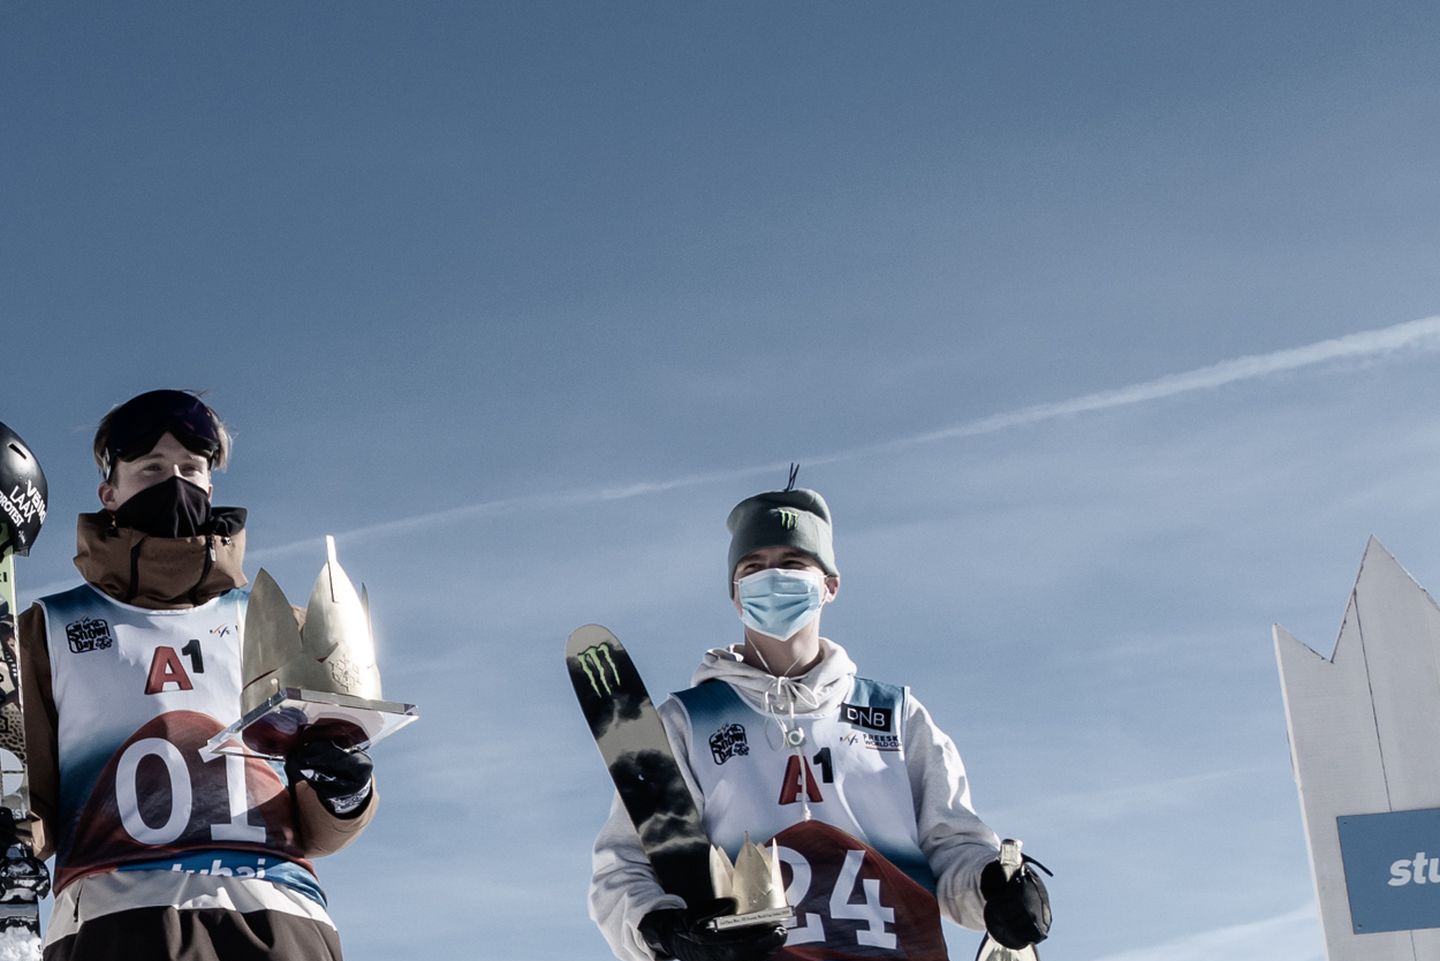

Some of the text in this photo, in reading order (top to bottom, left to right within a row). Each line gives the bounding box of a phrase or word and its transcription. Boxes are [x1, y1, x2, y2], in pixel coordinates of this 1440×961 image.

[10, 485, 36, 523] LAAX
[144, 639, 205, 695] A1
[846, 707, 886, 728] DNB
[116, 737, 267, 845] 01
[778, 747, 834, 805] A1
[764, 845, 898, 950] 24
